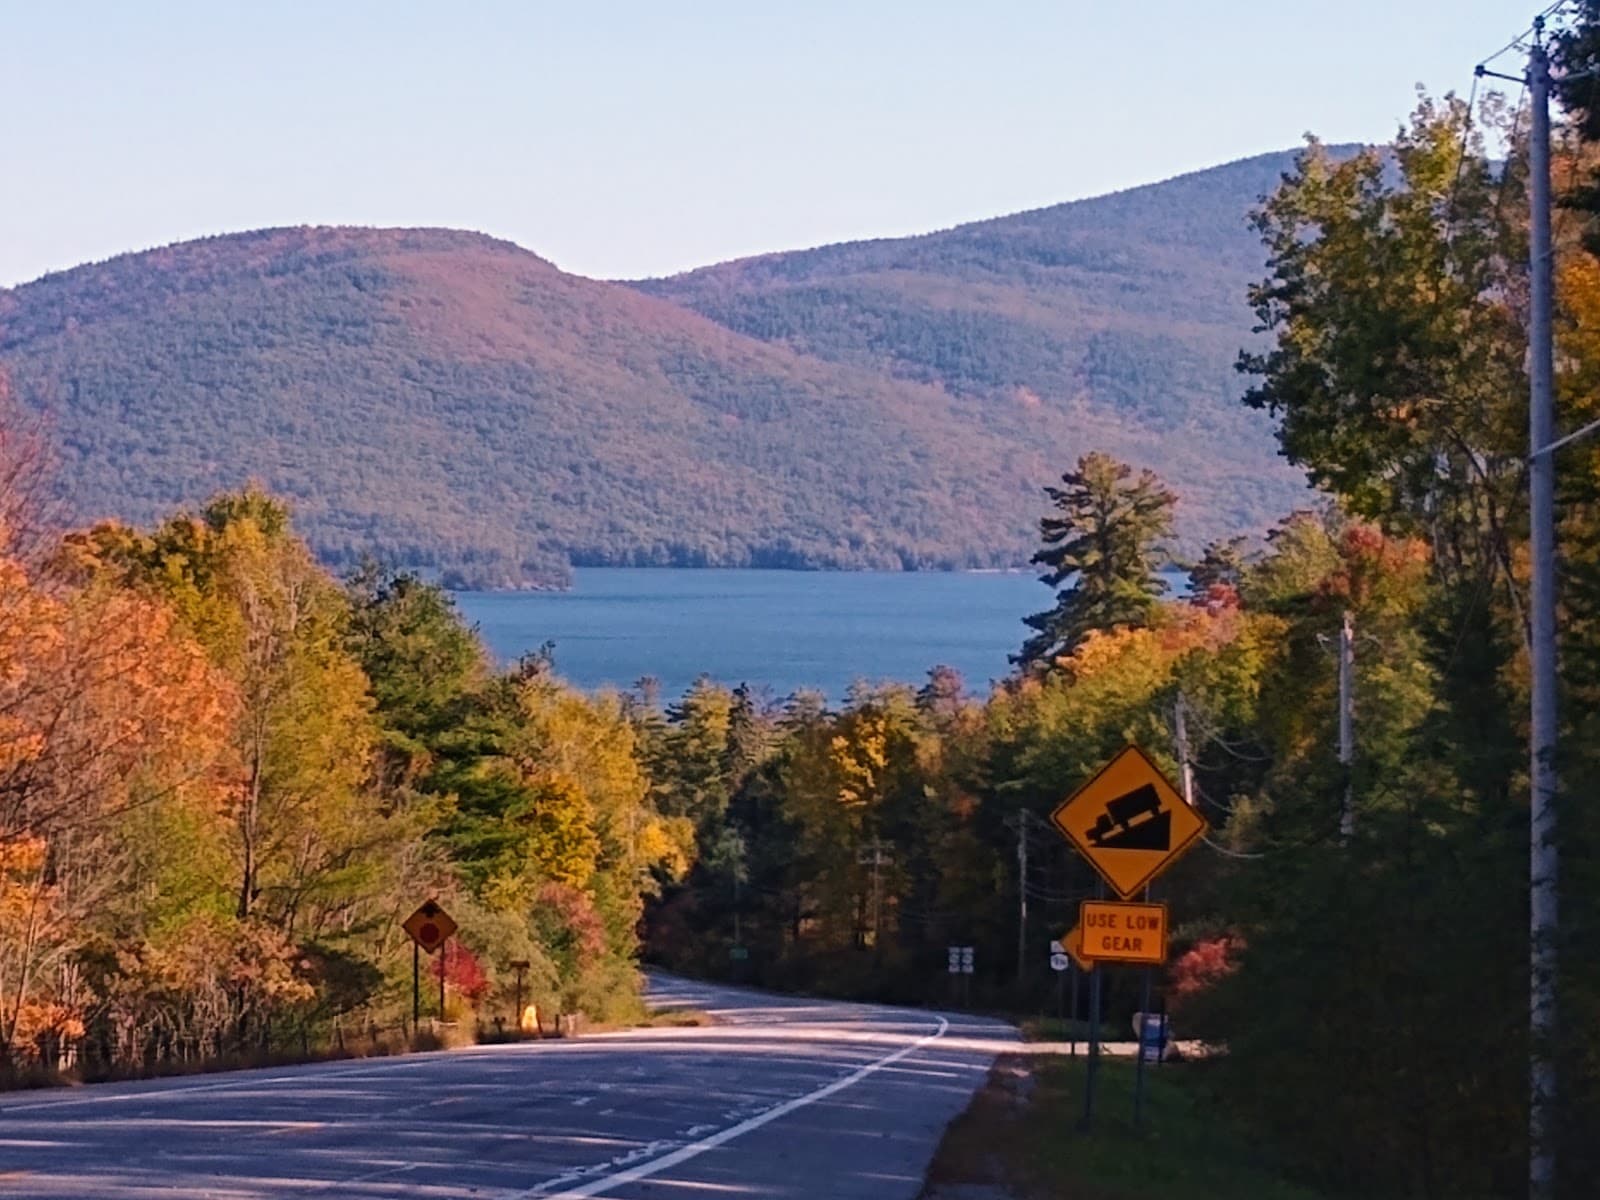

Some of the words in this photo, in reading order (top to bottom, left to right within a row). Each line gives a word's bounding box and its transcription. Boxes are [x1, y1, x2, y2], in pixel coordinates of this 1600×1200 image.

[1086, 913, 1117, 929] USE
[1126, 915, 1159, 931] LOW
[1102, 935, 1142, 952] GEAR
